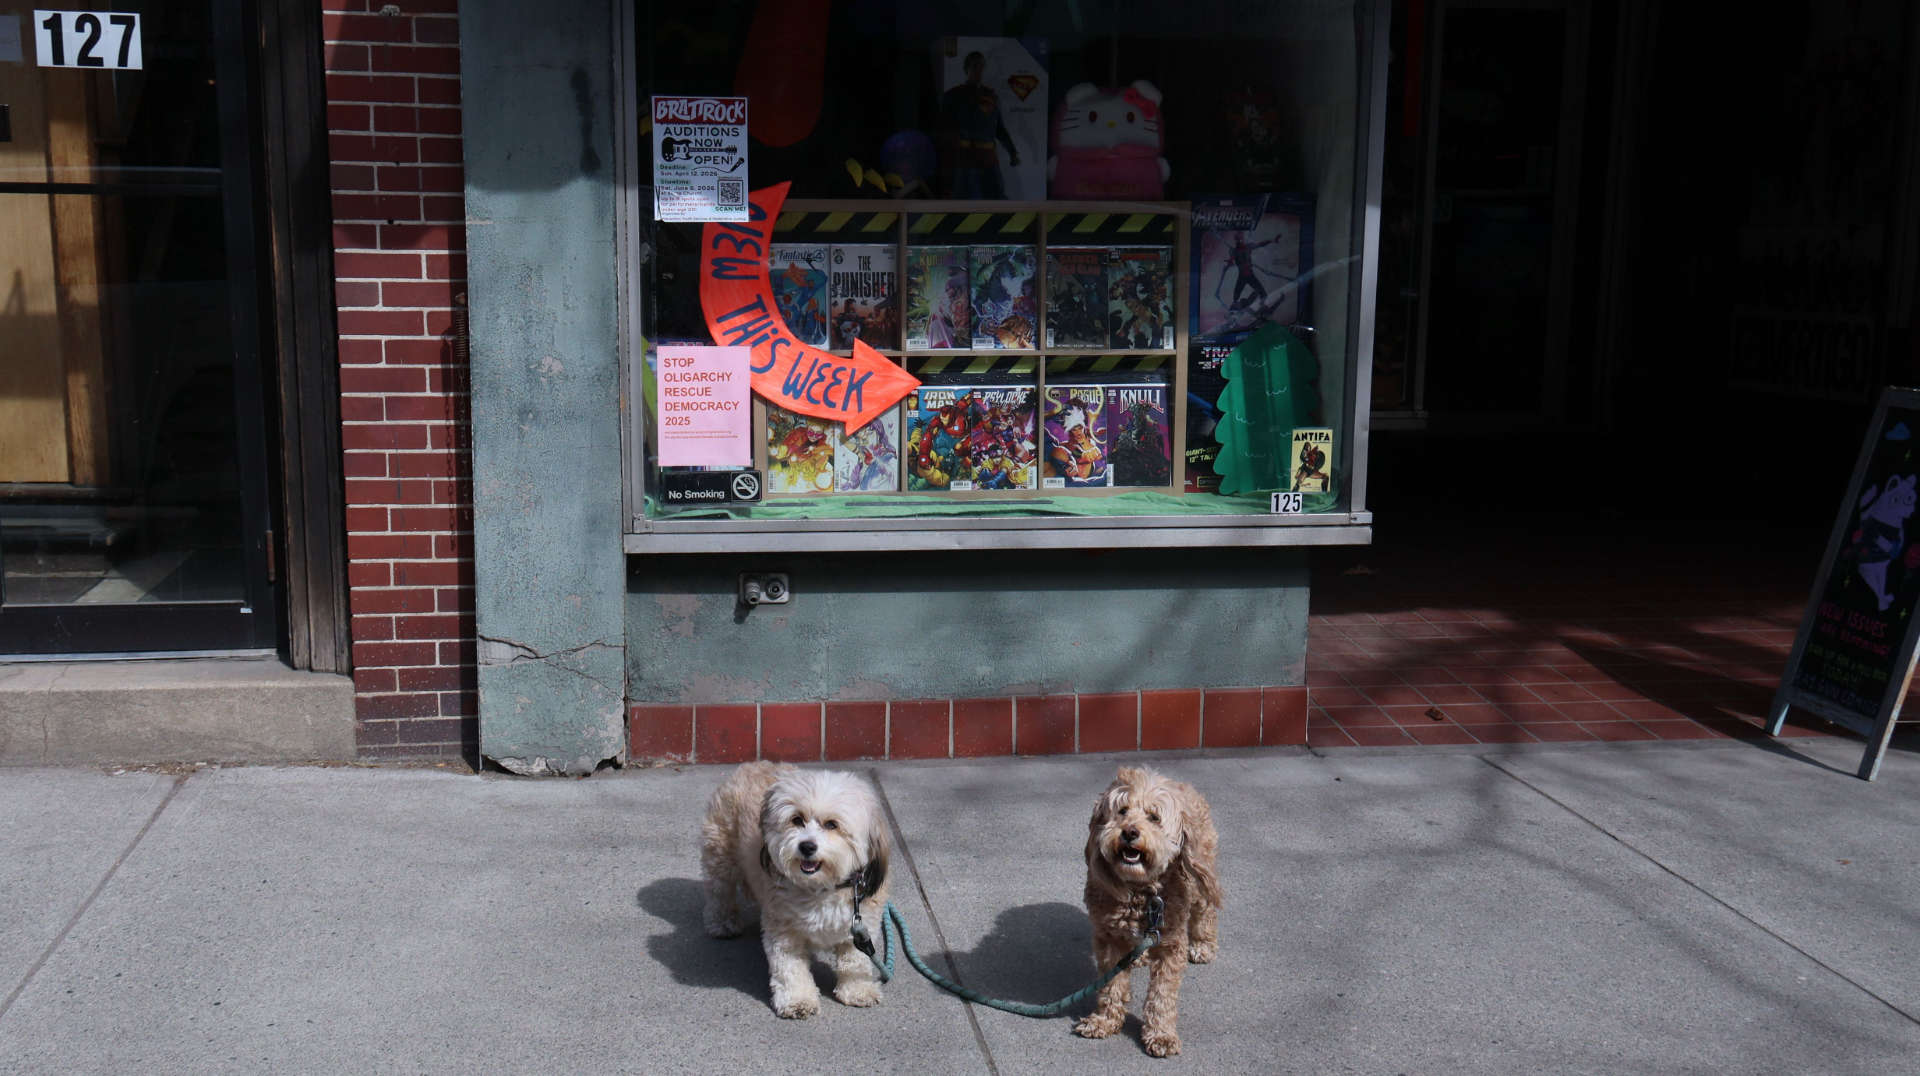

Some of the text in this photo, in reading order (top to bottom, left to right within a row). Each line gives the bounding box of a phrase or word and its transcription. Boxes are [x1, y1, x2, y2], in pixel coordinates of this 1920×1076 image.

[42, 13, 136, 68] 127
[656, 98, 745, 123] BRATTROCK
[663, 127, 740, 137] AUDITIONS
[694, 138, 723, 147] NOW
[694, 155, 733, 165] OPEN!
[858, 255, 871, 270] THE
[832, 271, 895, 298] PUNISHER
[664, 358, 695, 368] STOP
[664, 372, 733, 383] OLIGARCHY
[782, 351, 874, 413] WEEK
[664, 387, 712, 397] RESCUE
[924, 391, 956, 400] IRON
[983, 390, 1029, 404] PSYLOCKE
[665, 401, 740, 411] DEMOCRACY
[1120, 389, 1165, 415] KNULL
[665, 416, 691, 426] 2025
[1294, 432, 1330, 442] ANTIFA
[668, 489, 725, 500] No Smoking
[1274, 494, 1301, 512] 125
